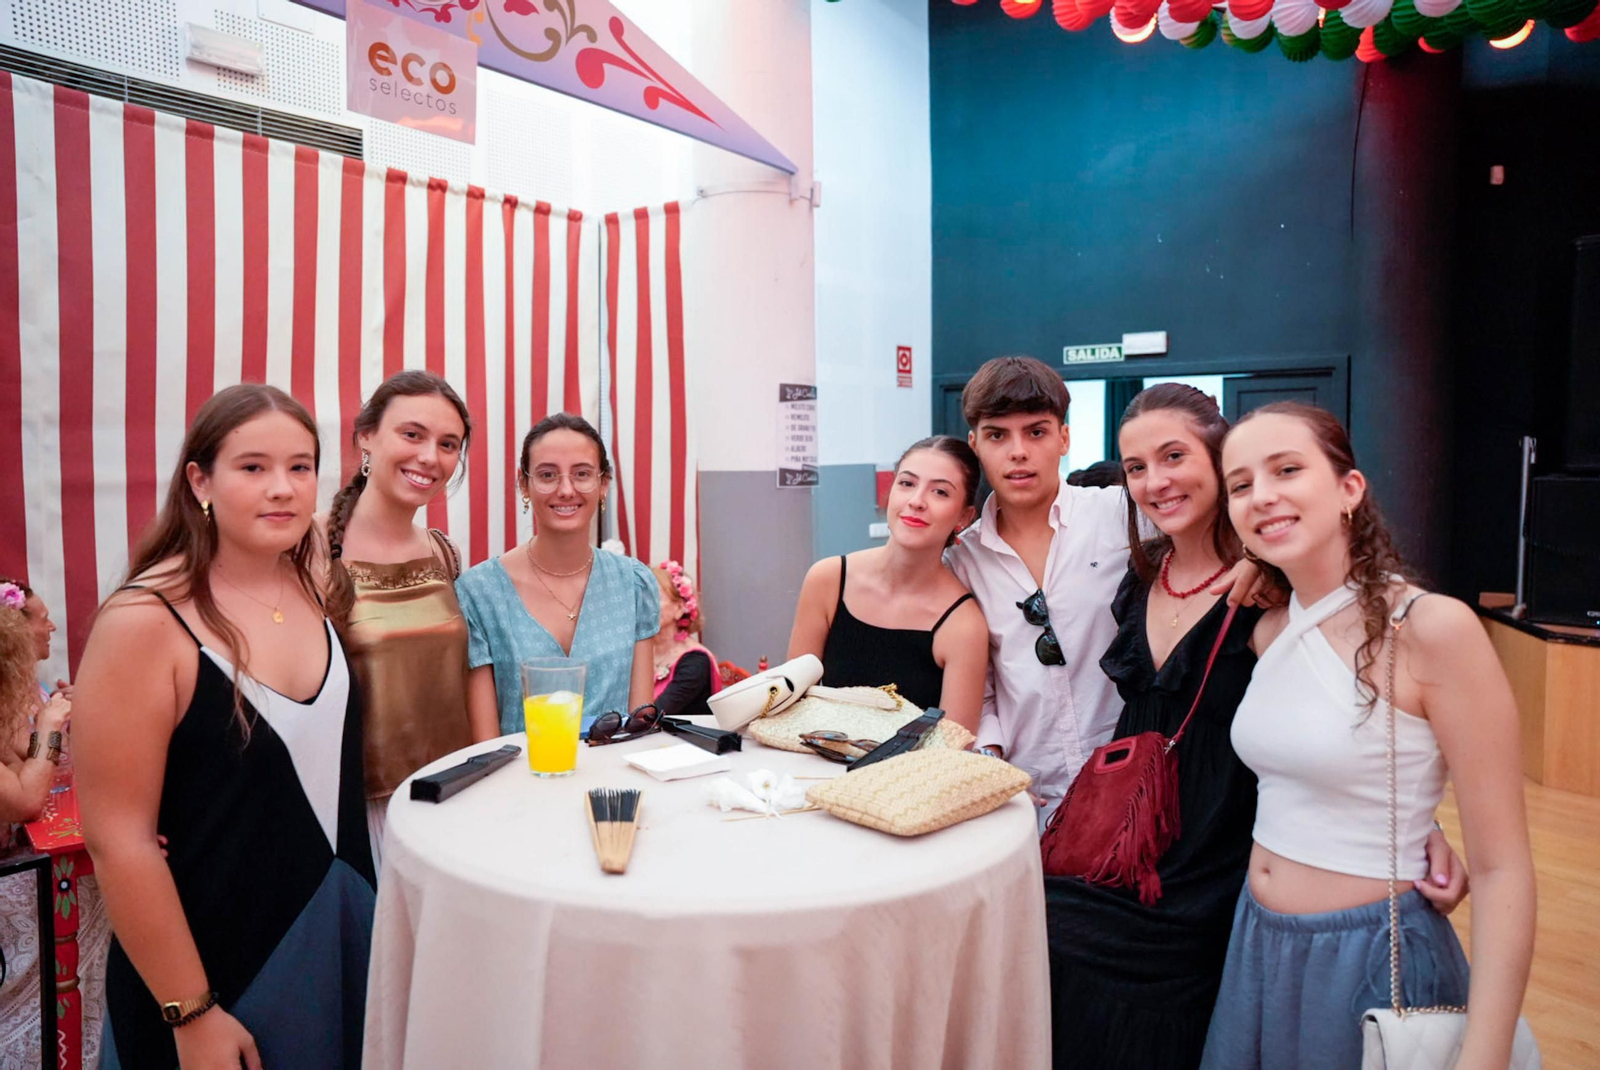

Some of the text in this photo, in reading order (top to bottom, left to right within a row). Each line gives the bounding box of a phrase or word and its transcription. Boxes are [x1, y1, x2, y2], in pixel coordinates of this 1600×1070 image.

[368, 42, 456, 95] eco
[369, 77, 457, 115] selectos
[1068, 347, 1120, 361] SALIDA
